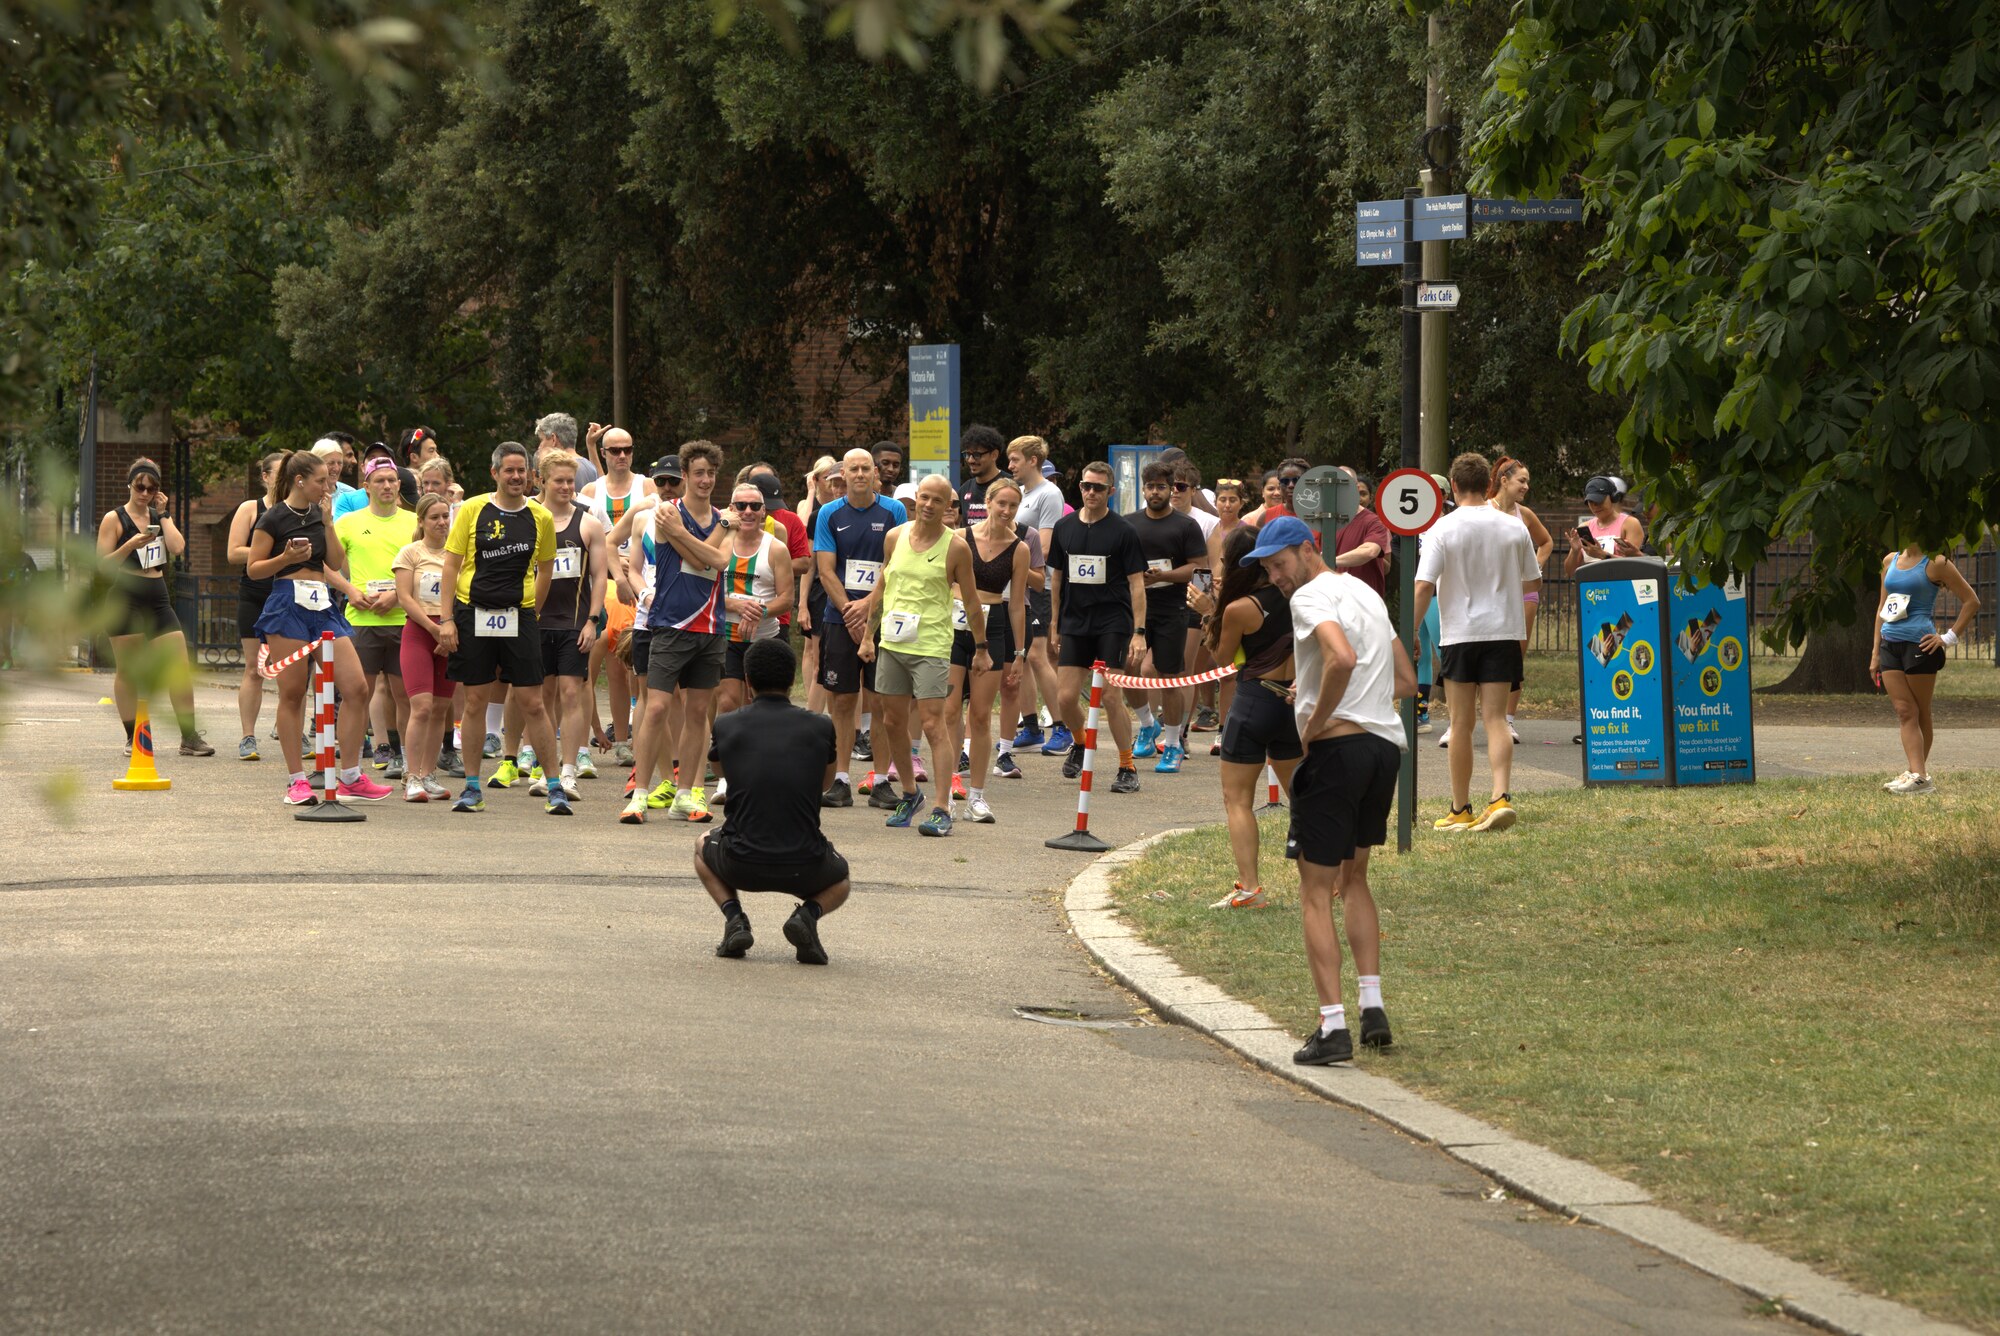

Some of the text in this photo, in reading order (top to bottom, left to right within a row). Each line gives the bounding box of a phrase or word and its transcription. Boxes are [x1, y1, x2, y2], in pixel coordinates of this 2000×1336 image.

[1511, 206, 1546, 216] Regent's
[1400, 489, 1418, 515] 5
[482, 542, 529, 559] Run&Frite
[553, 557, 571, 571] 11
[1078, 564, 1095, 577] 64
[857, 570, 874, 584] 74
[431, 582, 440, 595] 4
[310, 590, 318, 603] 4
[486, 615, 507, 629] 40
[958, 610, 966, 623] 2
[895, 621, 903, 634] 7
[1590, 706, 1642, 720] You find it,
[1678, 702, 1733, 716] You find it,
[1591, 722, 1629, 734] we fix it
[1679, 720, 1719, 733] we fix it
